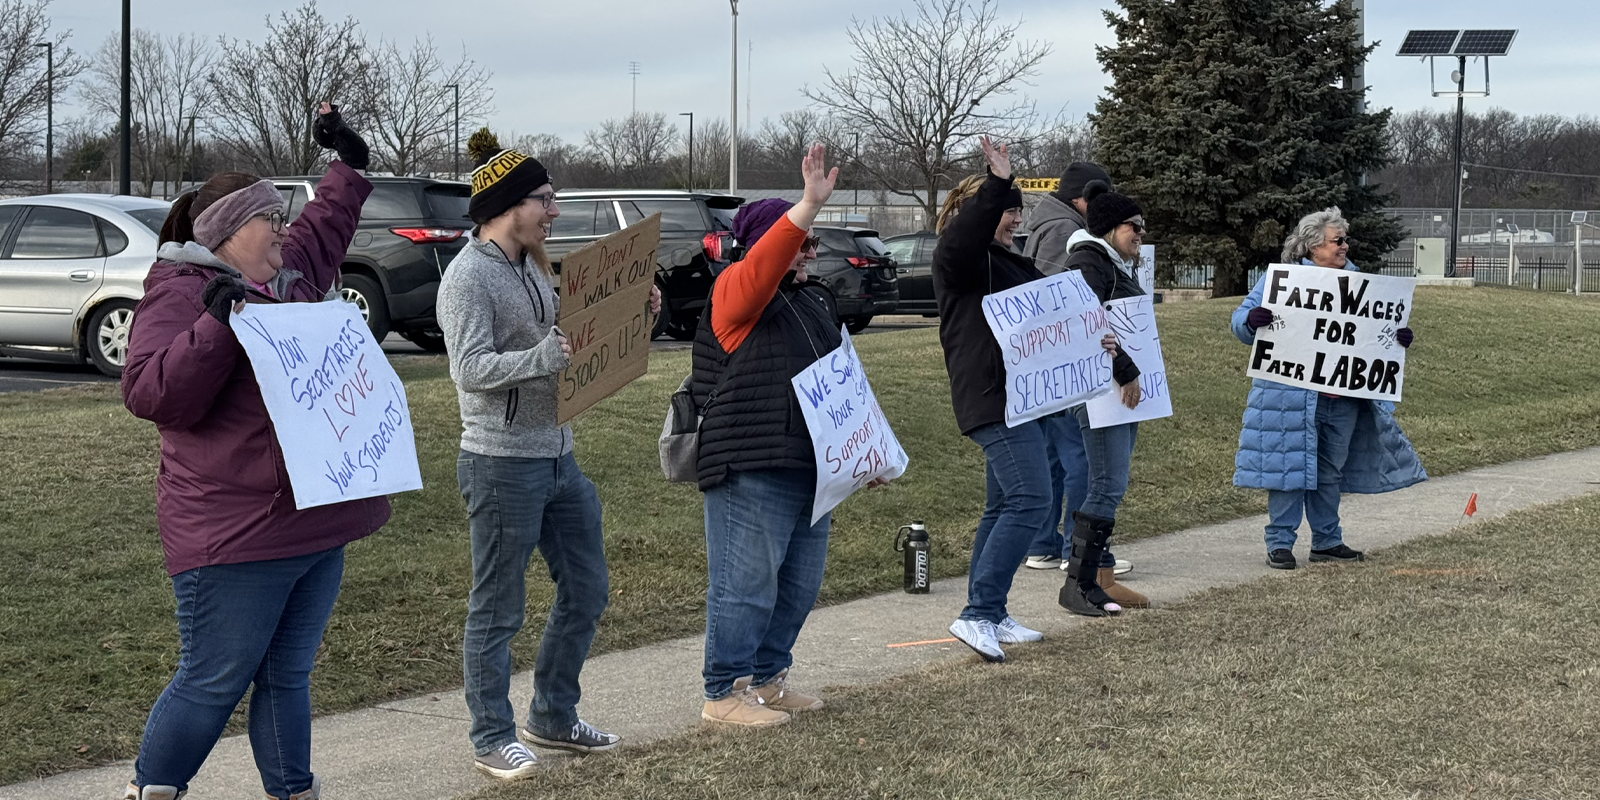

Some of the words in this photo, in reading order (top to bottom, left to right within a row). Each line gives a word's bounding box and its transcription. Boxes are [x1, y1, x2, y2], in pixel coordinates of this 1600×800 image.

[1020, 180, 1051, 189] SELF
[567, 264, 590, 297] WE
[584, 267, 623, 309] WALK
[627, 249, 656, 285] OUT
[1268, 270, 1334, 312] FAIR
[987, 290, 1045, 331] HONK
[1046, 281, 1067, 311] IF
[1066, 271, 1096, 305] YOU
[570, 317, 596, 355] WE
[1078, 305, 1109, 340] YOUR
[1312, 318, 1357, 346] FOR
[1377, 335, 1393, 349] 478
[290, 318, 366, 410] SECRETARIES
[564, 343, 610, 401] STOOD
[1014, 350, 1113, 415] SECRETARIES
[1251, 339, 1306, 381] FAIR
[1310, 351, 1400, 395] LABOR
[799, 369, 832, 409] WE
[826, 398, 855, 430] YOUR
[826, 412, 875, 475] SUPPORT
[326, 452, 358, 495] YOUR
[918, 550, 927, 587] TOLEDO
